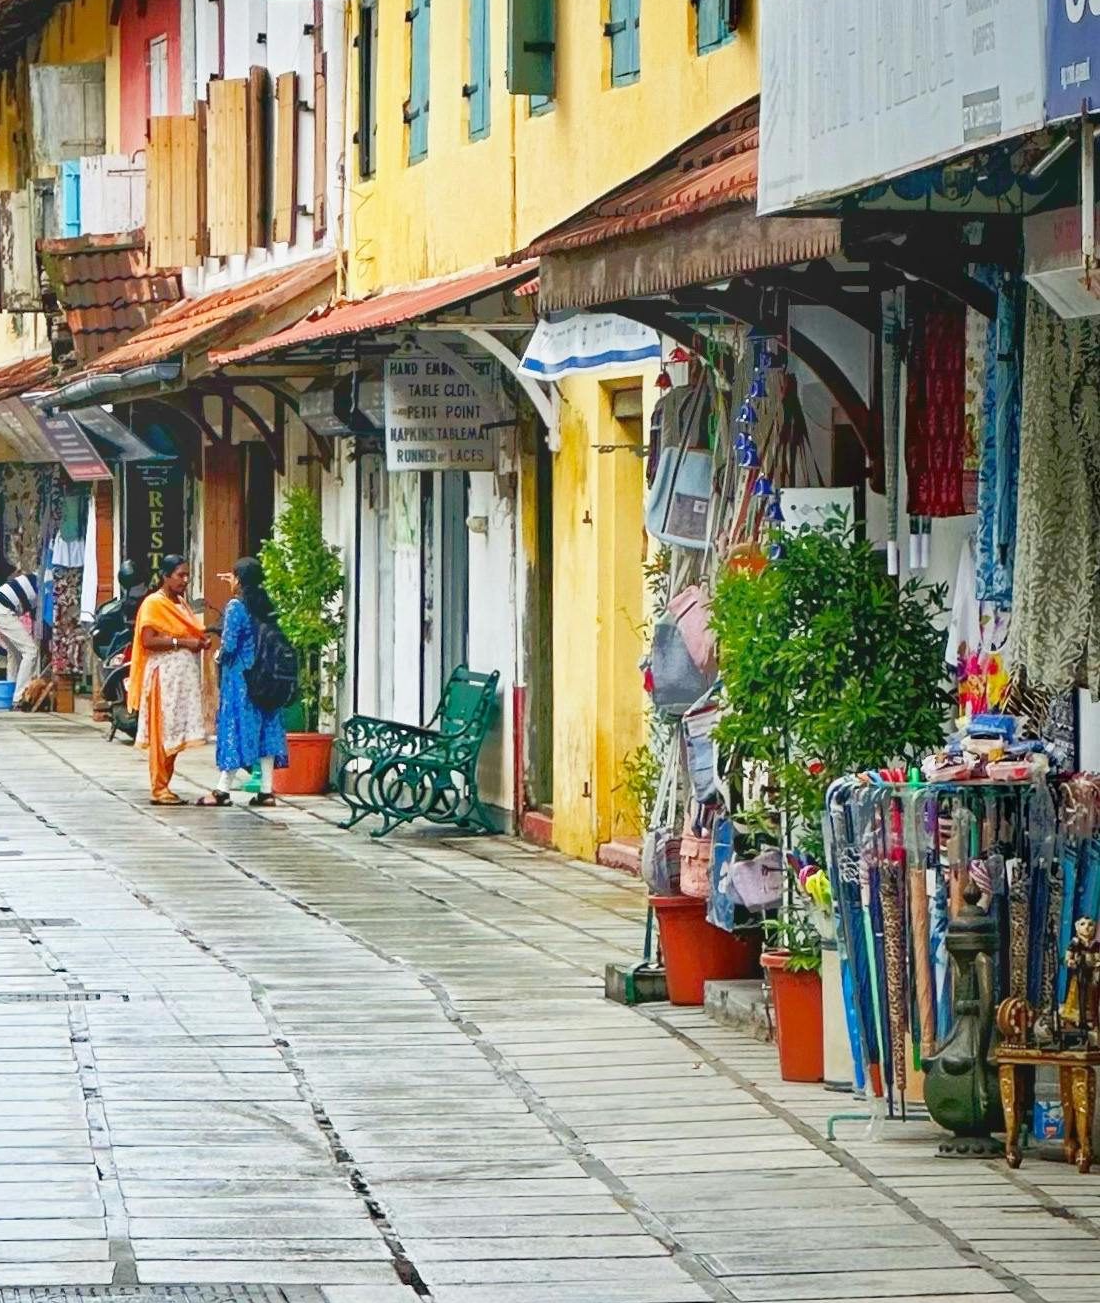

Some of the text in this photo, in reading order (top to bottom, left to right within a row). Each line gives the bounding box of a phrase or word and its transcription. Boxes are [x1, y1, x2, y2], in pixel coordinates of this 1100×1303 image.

[390, 362, 418, 375] HAND
[408, 384, 440, 397] TABLE
[445, 405, 481, 419] POINT
[450, 449, 484, 463] LACES
